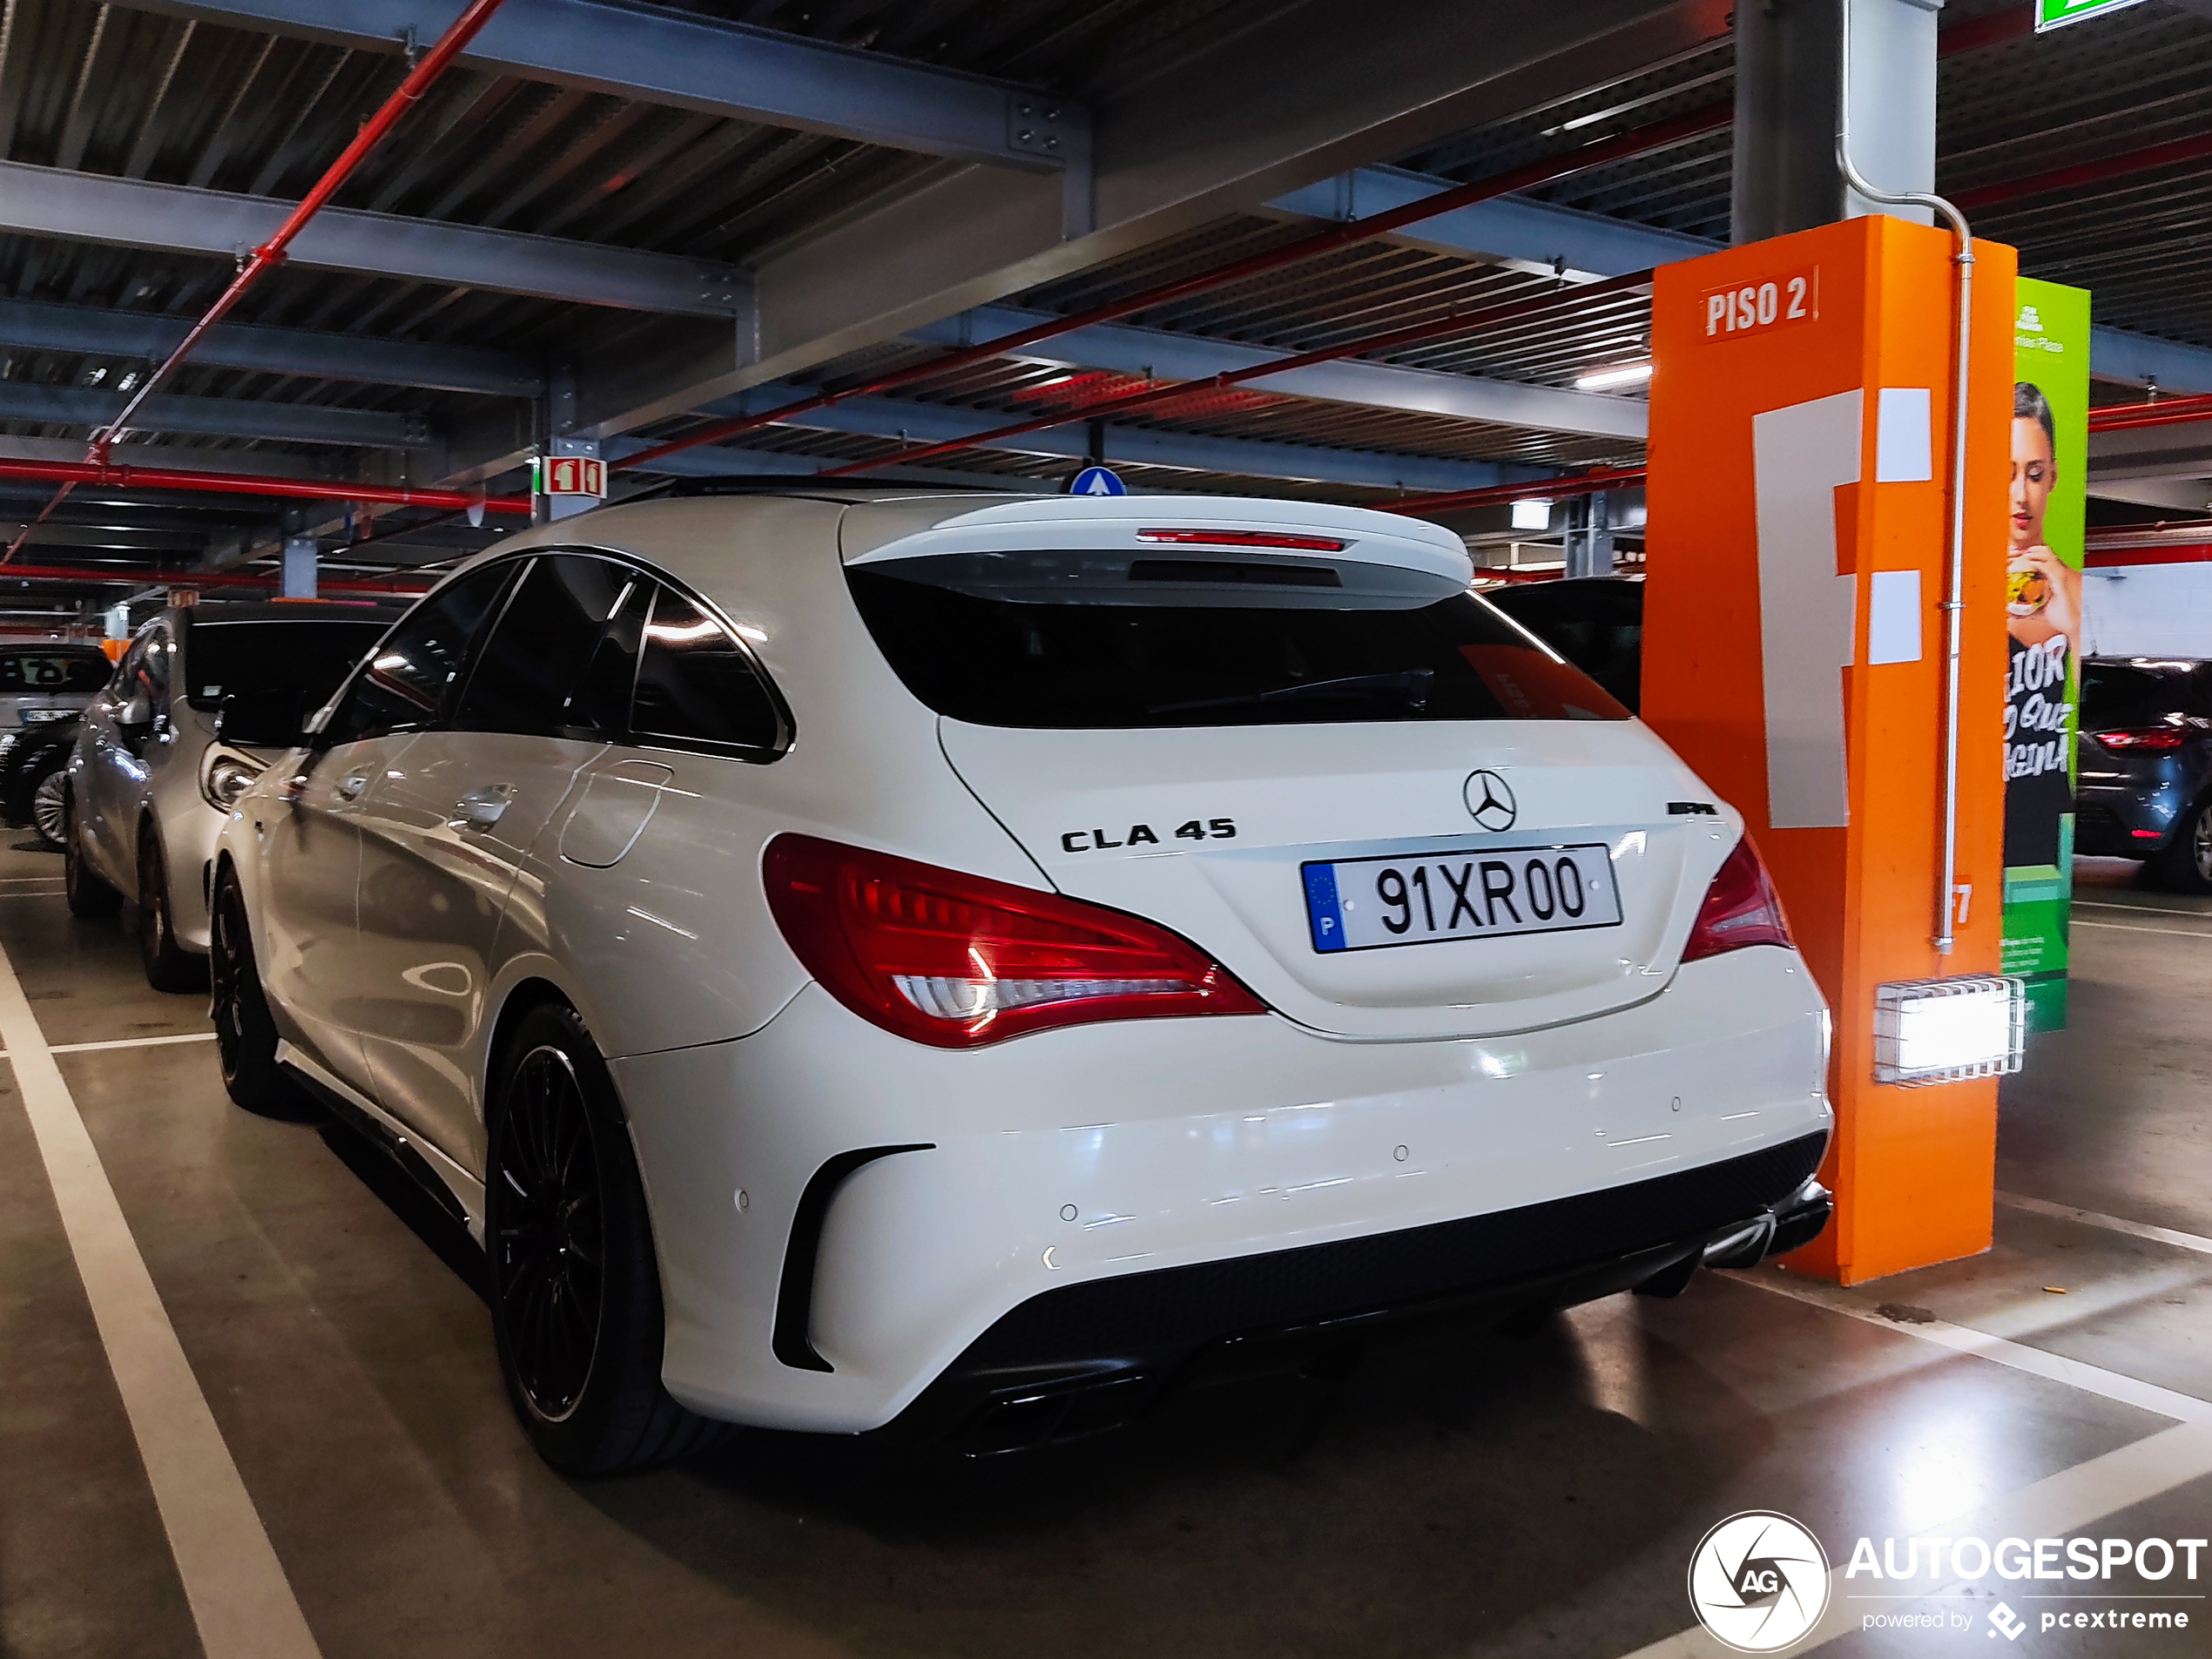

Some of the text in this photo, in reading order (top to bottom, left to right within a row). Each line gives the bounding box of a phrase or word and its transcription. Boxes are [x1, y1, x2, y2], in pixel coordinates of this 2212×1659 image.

[1707, 276, 1807, 336] PISO 2
[1062, 818, 1237, 853] CLA 45
[1377, 856, 1586, 934] 91XR00
[1952, 883, 1973, 923] 7
[1320, 917, 1335, 935] P
